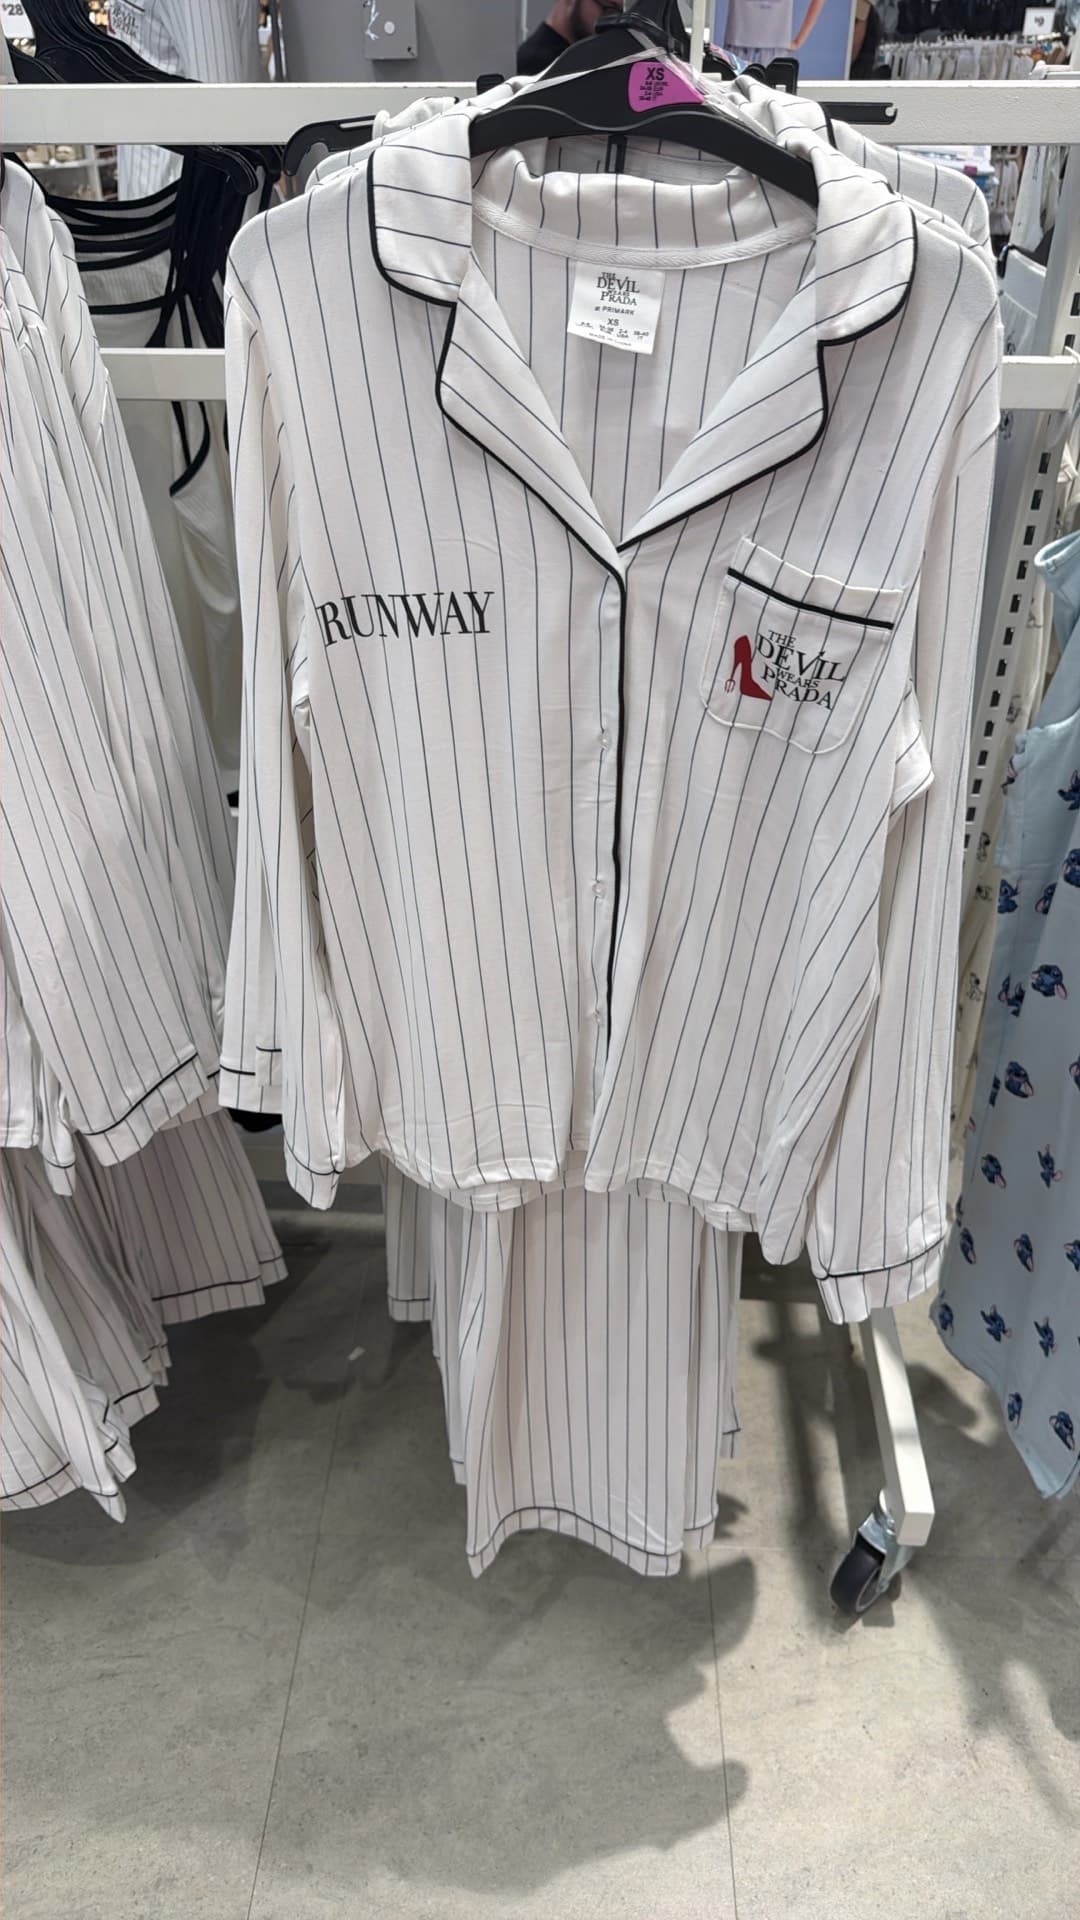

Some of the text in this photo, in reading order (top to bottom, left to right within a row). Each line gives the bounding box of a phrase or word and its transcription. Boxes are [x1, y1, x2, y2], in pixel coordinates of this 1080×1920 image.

[646, 67, 665, 81] XS
[596, 276, 640, 294] DEVIL
[601, 271, 617, 281] THE
[600, 291, 637, 306] PRADA
[602, 306, 635, 316] PRIMARK
[607, 318, 619, 327] XS
[315, 591, 495, 648] RUNWAY
[768, 629, 797, 648] THE
[757, 633, 847, 683] DEVIL
[761, 662, 833, 711] PRADA
[776, 668, 820, 688] WEARS
